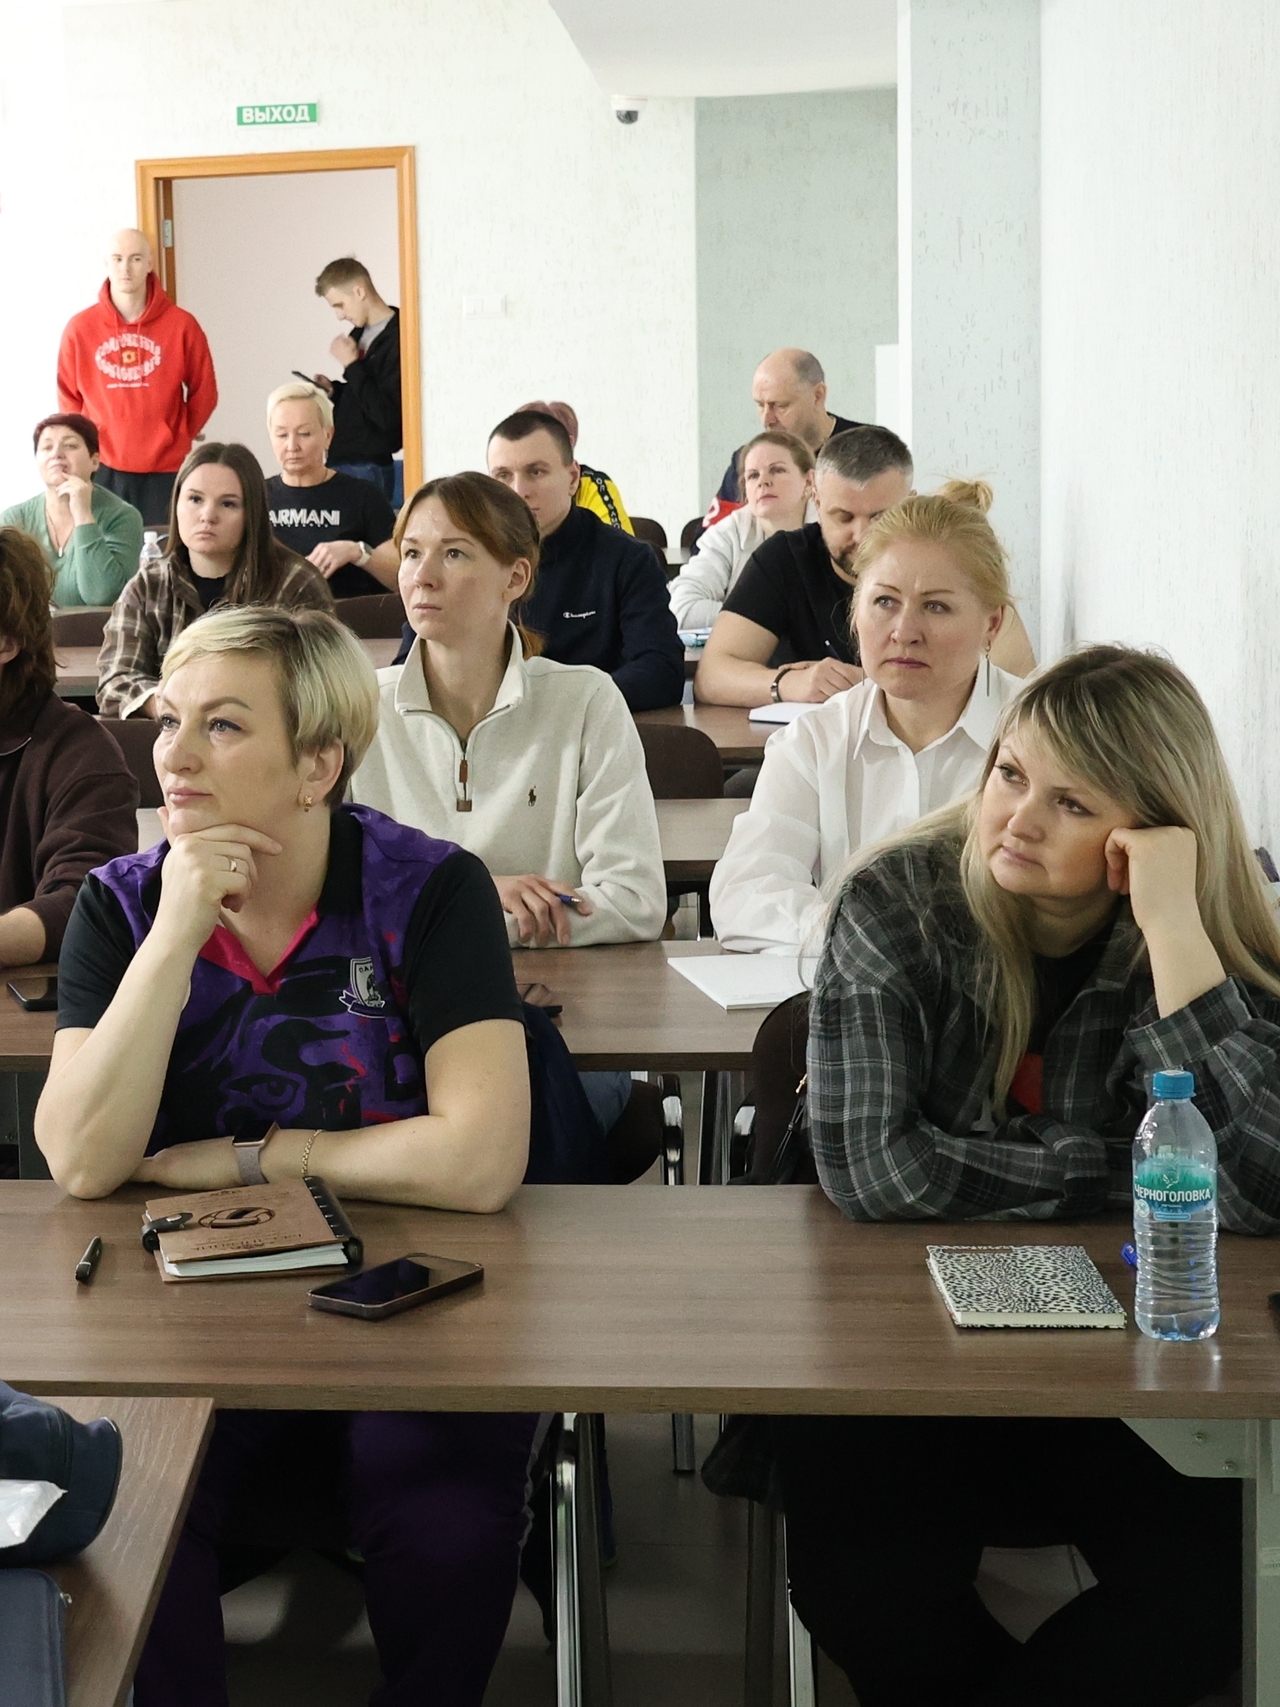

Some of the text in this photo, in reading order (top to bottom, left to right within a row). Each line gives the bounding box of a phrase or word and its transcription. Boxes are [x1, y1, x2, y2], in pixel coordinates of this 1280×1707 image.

[242, 105, 310, 123] ВЫХОД
[268, 508, 340, 526] ARMANI
[1134, 1183, 1211, 1203] ЧЕРНОГОЛОВКА
